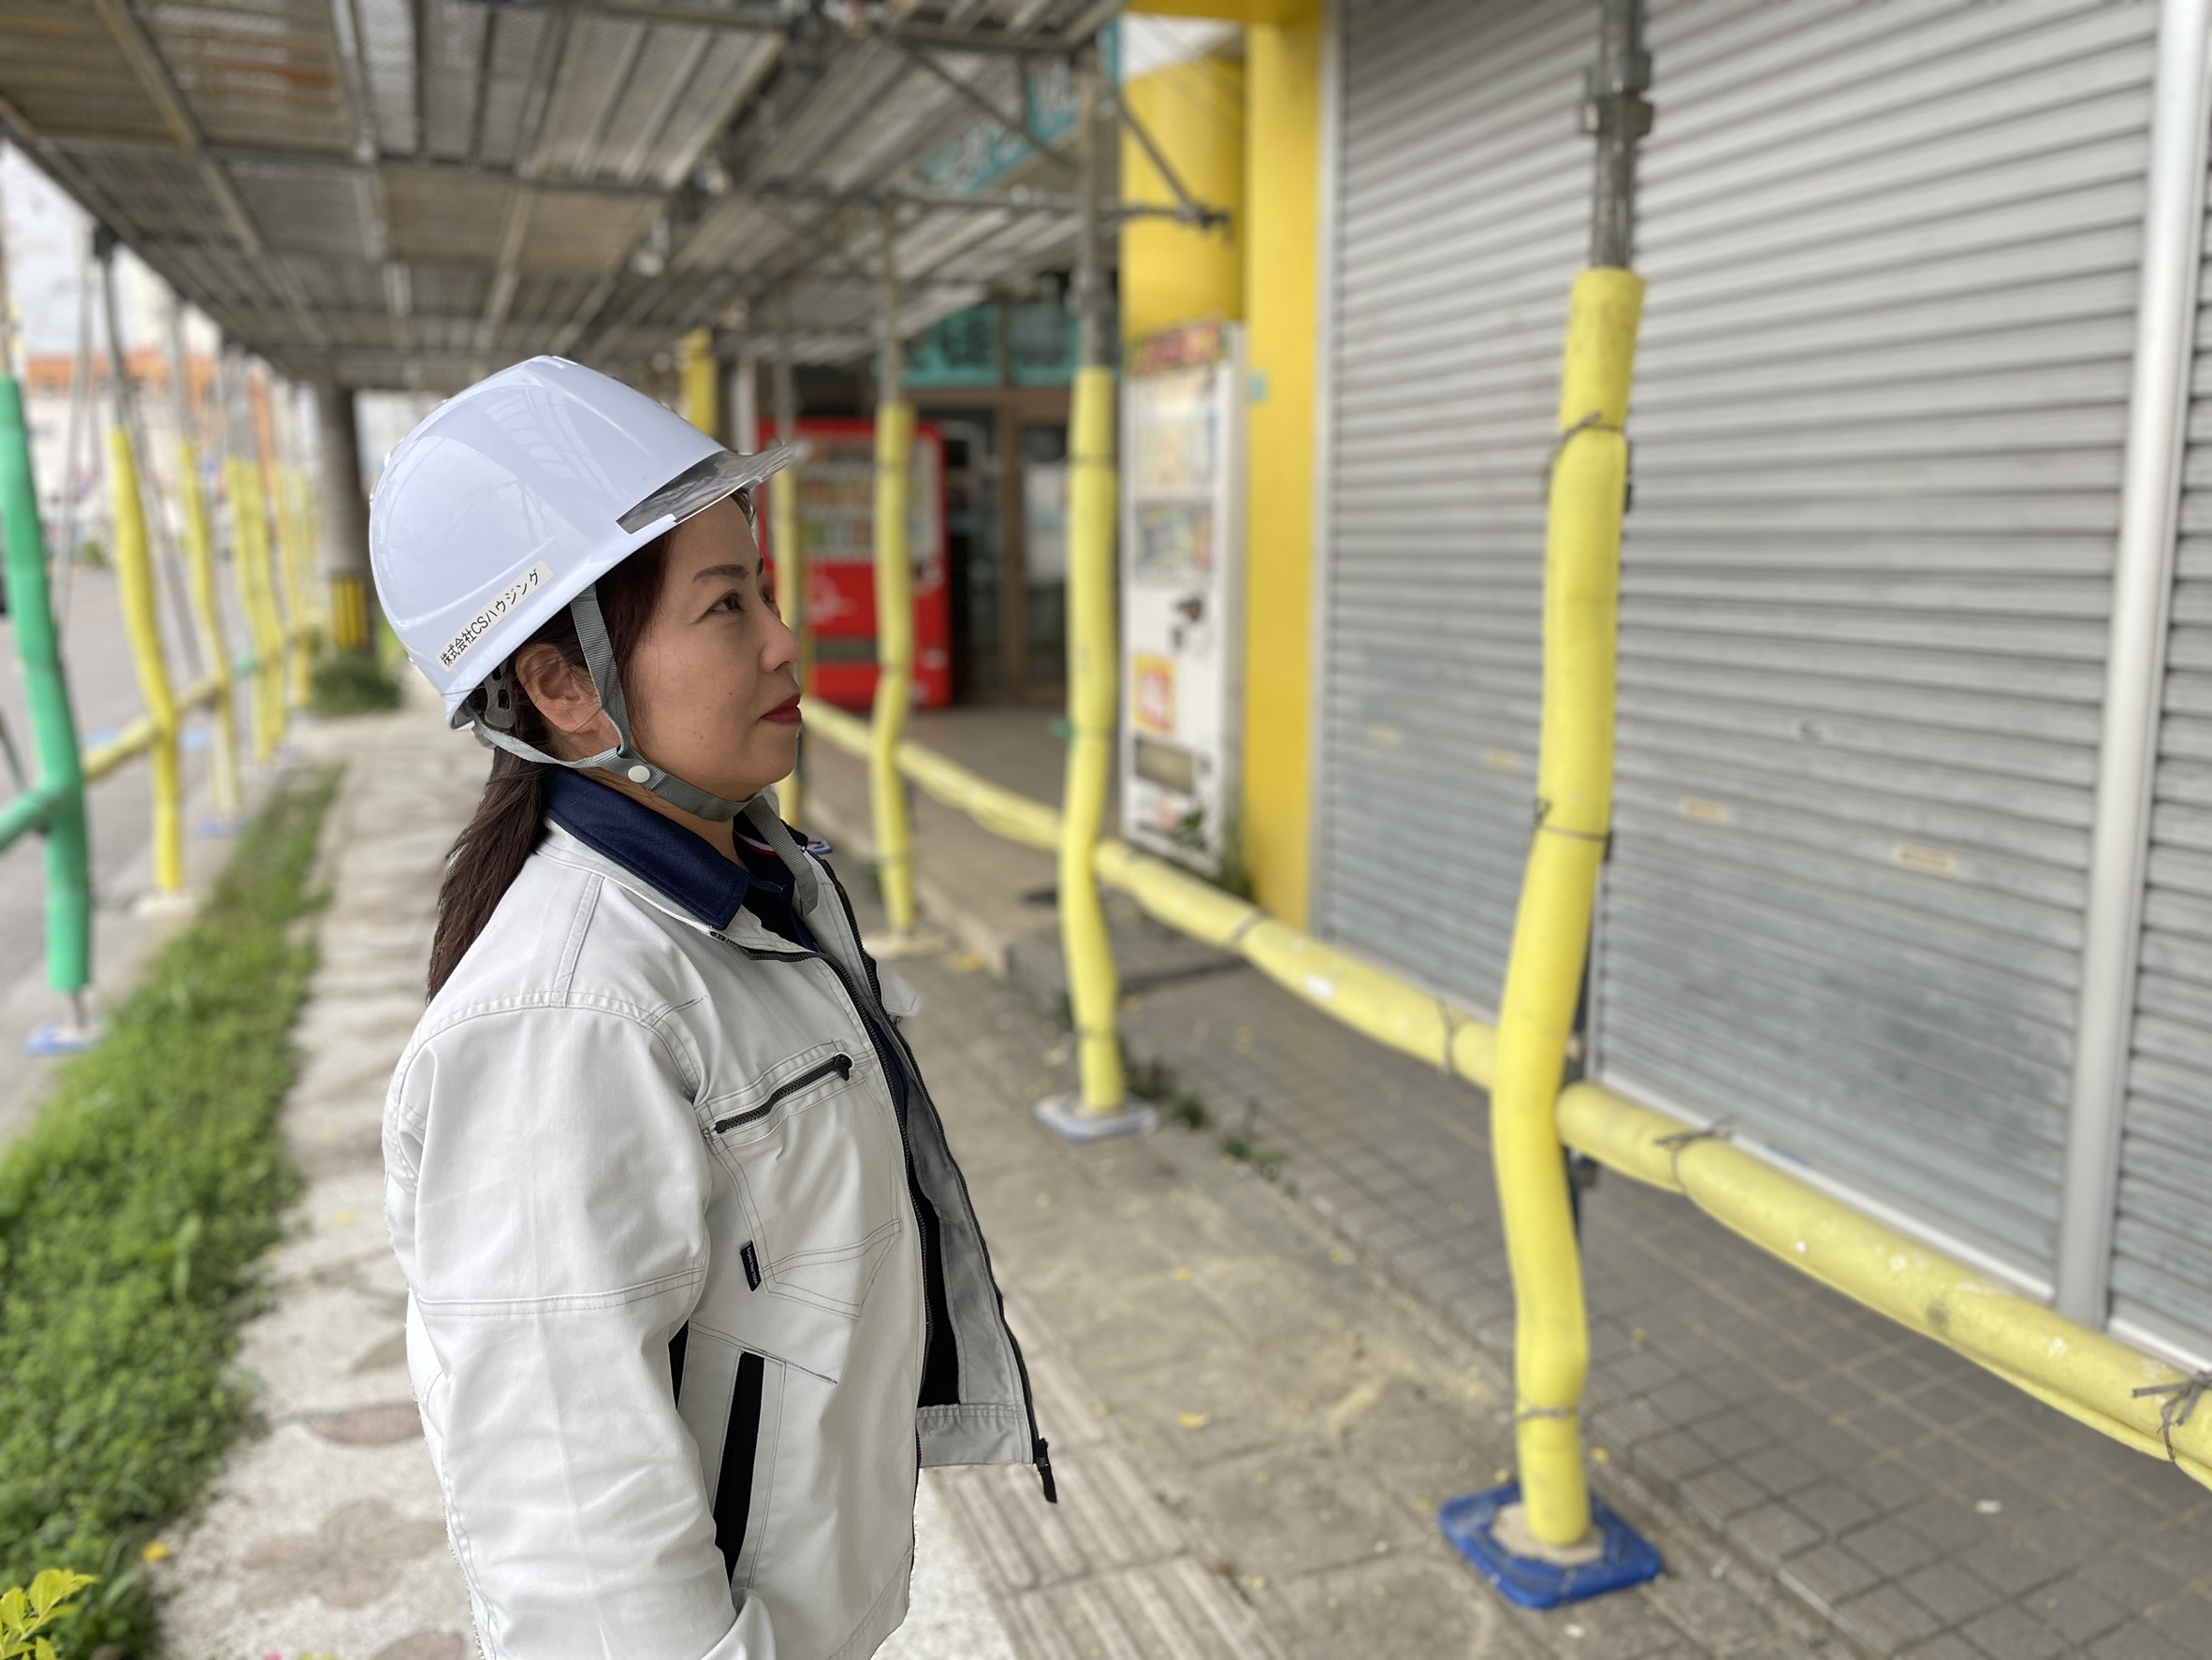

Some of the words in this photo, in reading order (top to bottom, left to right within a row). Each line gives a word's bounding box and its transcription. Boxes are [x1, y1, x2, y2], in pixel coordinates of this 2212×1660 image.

[440, 568, 539, 667] 株式会社CSハウジング
